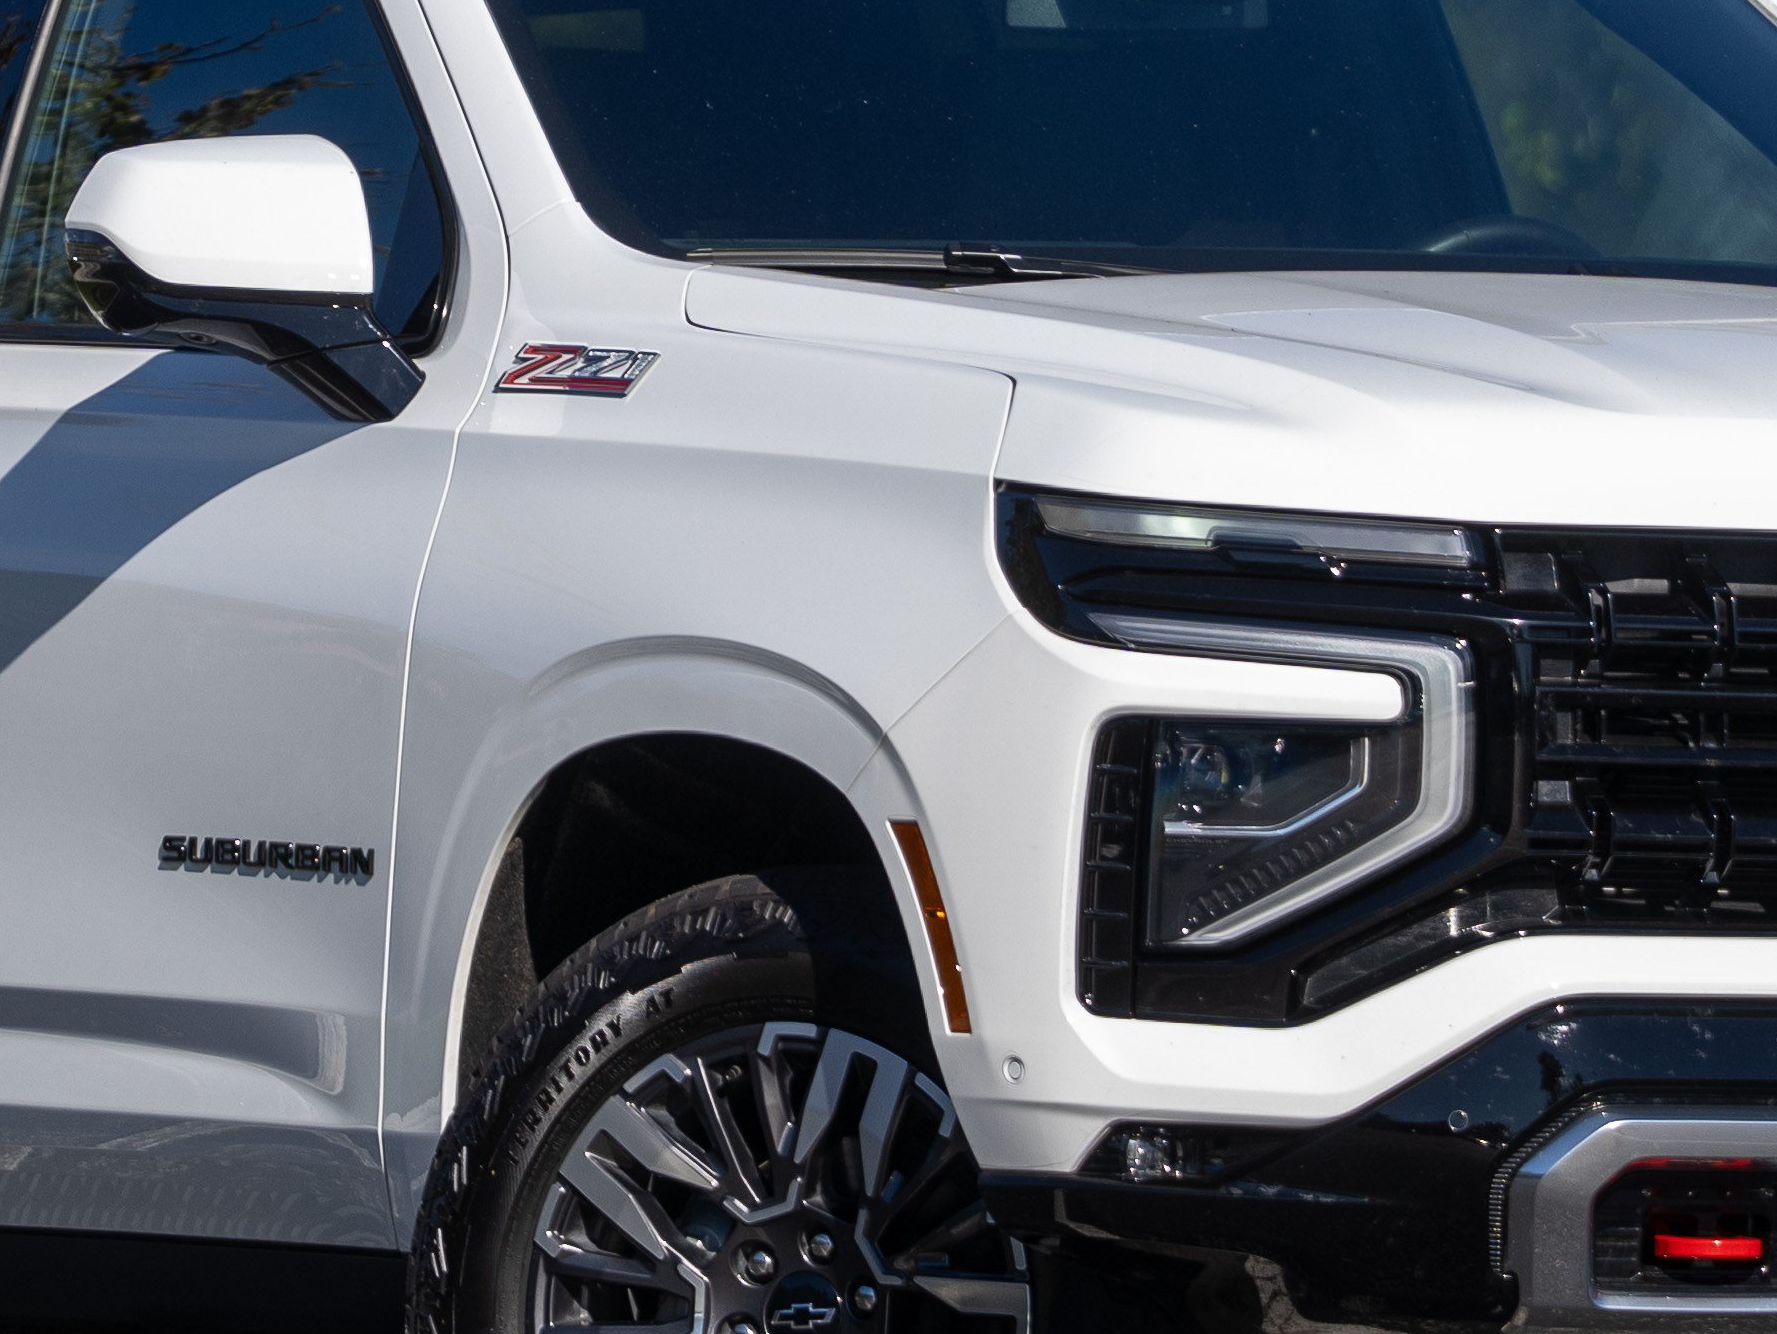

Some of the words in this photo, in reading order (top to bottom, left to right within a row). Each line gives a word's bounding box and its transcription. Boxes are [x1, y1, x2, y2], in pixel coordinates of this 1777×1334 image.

[493, 341, 661, 398] Z71
[158, 834, 375, 877] SUBURBAN
[506, 1014, 624, 1167] TERRITORY
[644, 985, 676, 1019] AT
